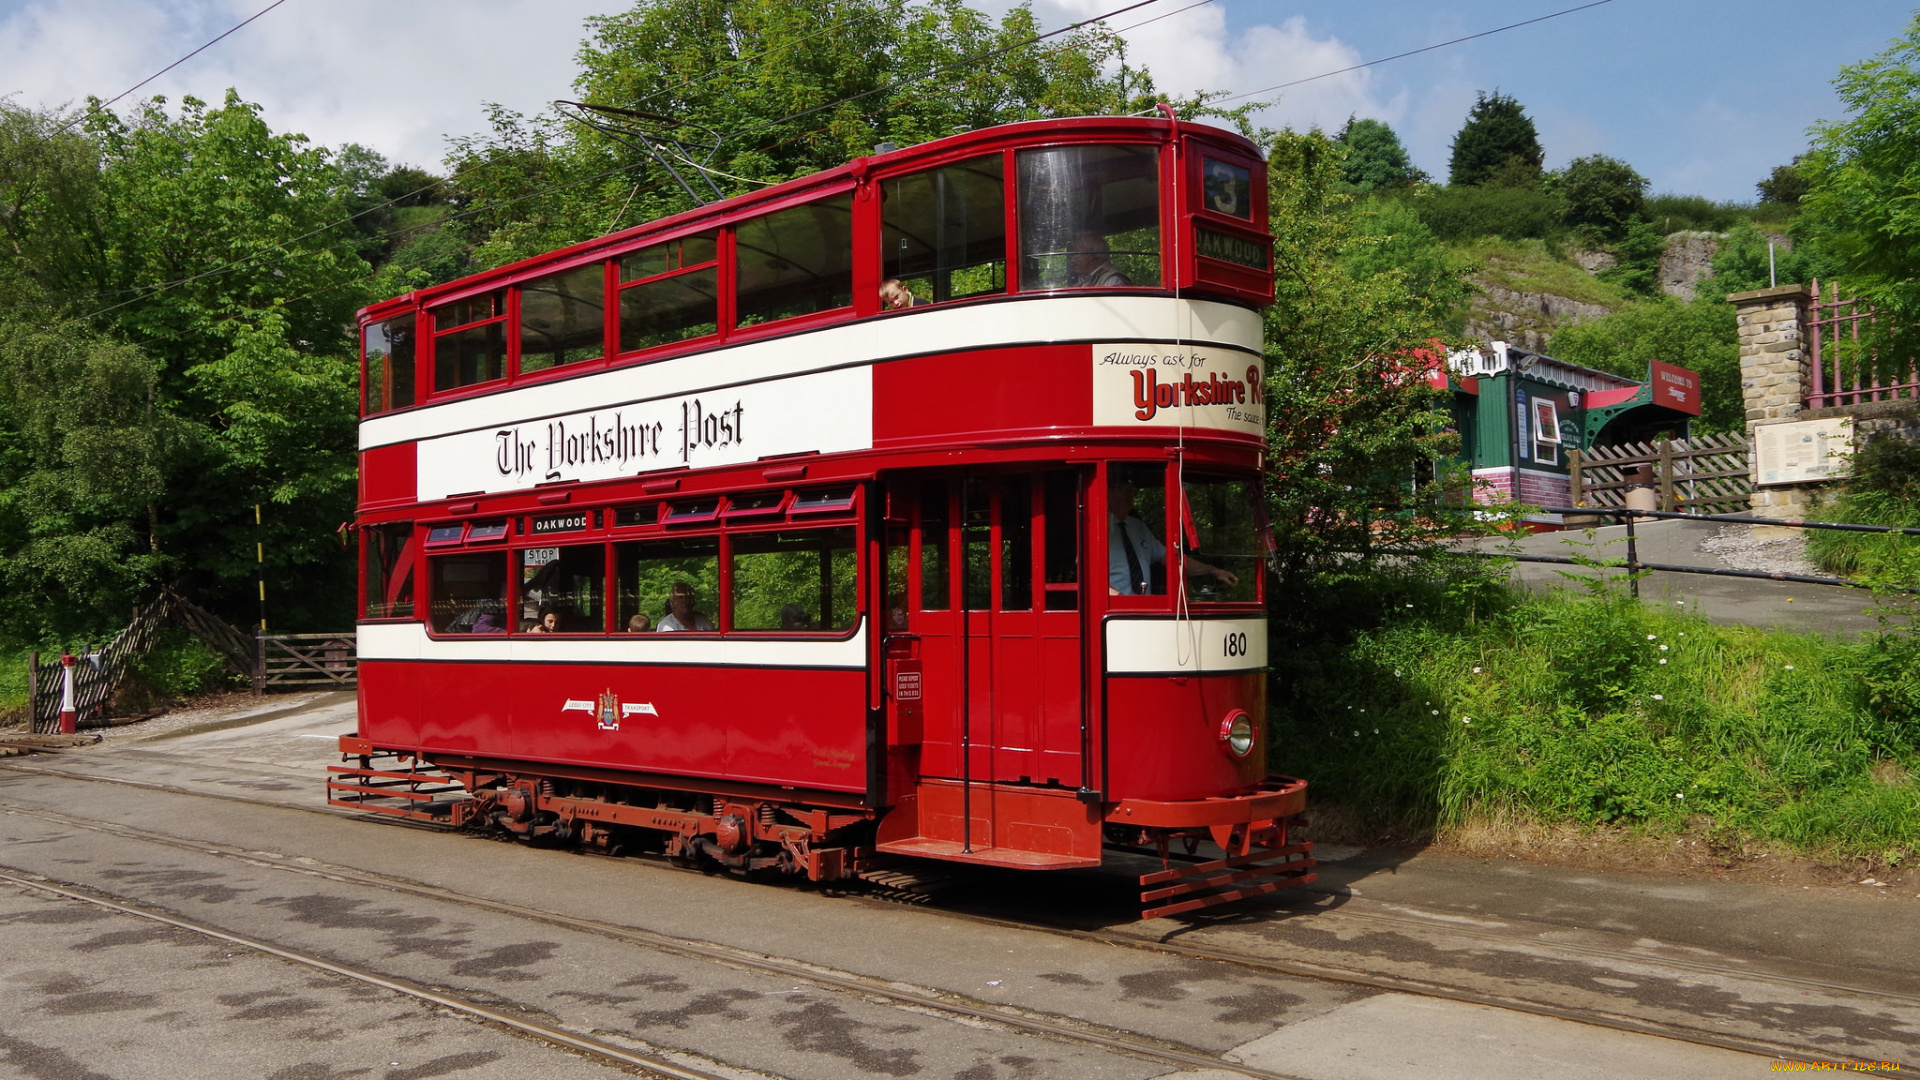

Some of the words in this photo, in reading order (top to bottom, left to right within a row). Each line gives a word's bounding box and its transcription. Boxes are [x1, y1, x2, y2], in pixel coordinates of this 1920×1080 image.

[1213, 164, 1237, 214] 3
[1099, 352, 1157, 368] Always
[1162, 354, 1185, 367] ask
[1187, 353, 1206, 369] for
[1130, 367, 1246, 421] Yorkshire
[1227, 407, 1242, 421] The
[1243, 412, 1260, 425] sauce
[495, 427, 536, 483] The
[545, 410, 663, 481] Yorkshire
[678, 398, 744, 463] Post
[536, 517, 586, 530] OAKWOOD
[528, 549, 554, 560] STOP
[1224, 632, 1247, 657] 180
